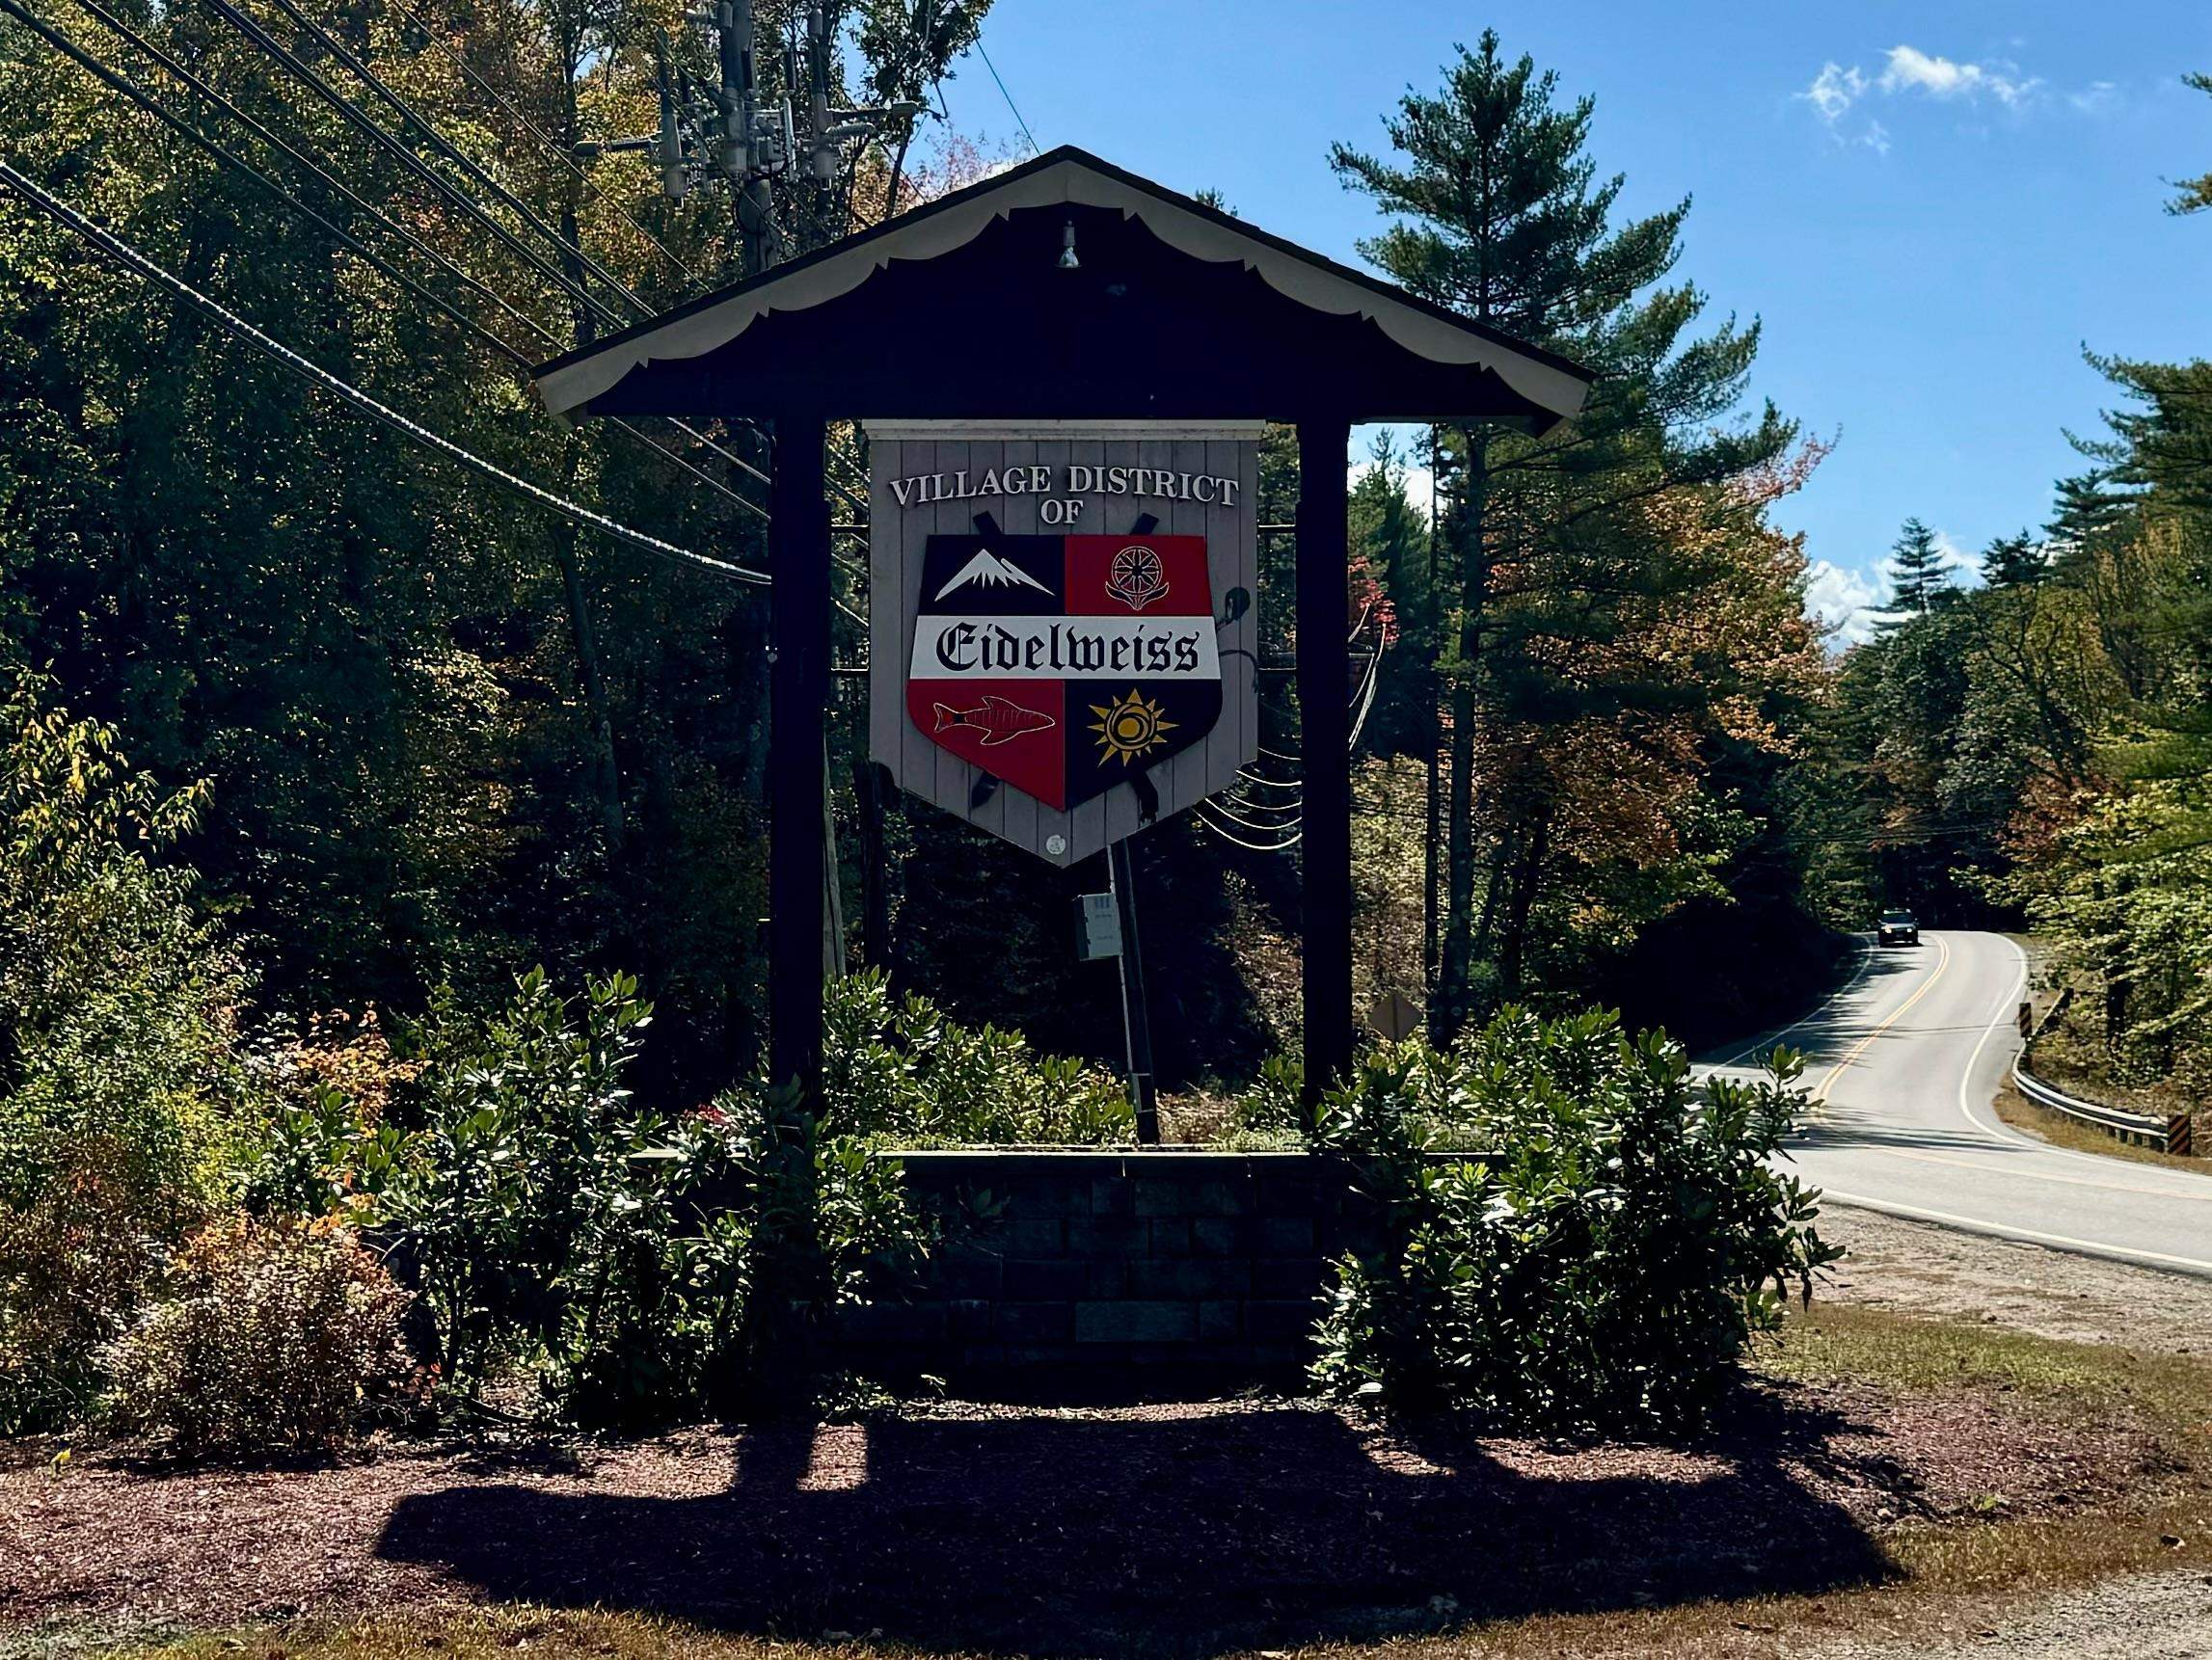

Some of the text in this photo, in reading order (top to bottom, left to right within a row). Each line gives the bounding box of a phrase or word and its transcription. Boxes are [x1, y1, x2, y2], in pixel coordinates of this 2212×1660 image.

[890, 466, 1239, 506] VILLAGE DISTRICT
[1040, 499, 1084, 524] OF
[935, 622, 1200, 672] Eidelweiss
